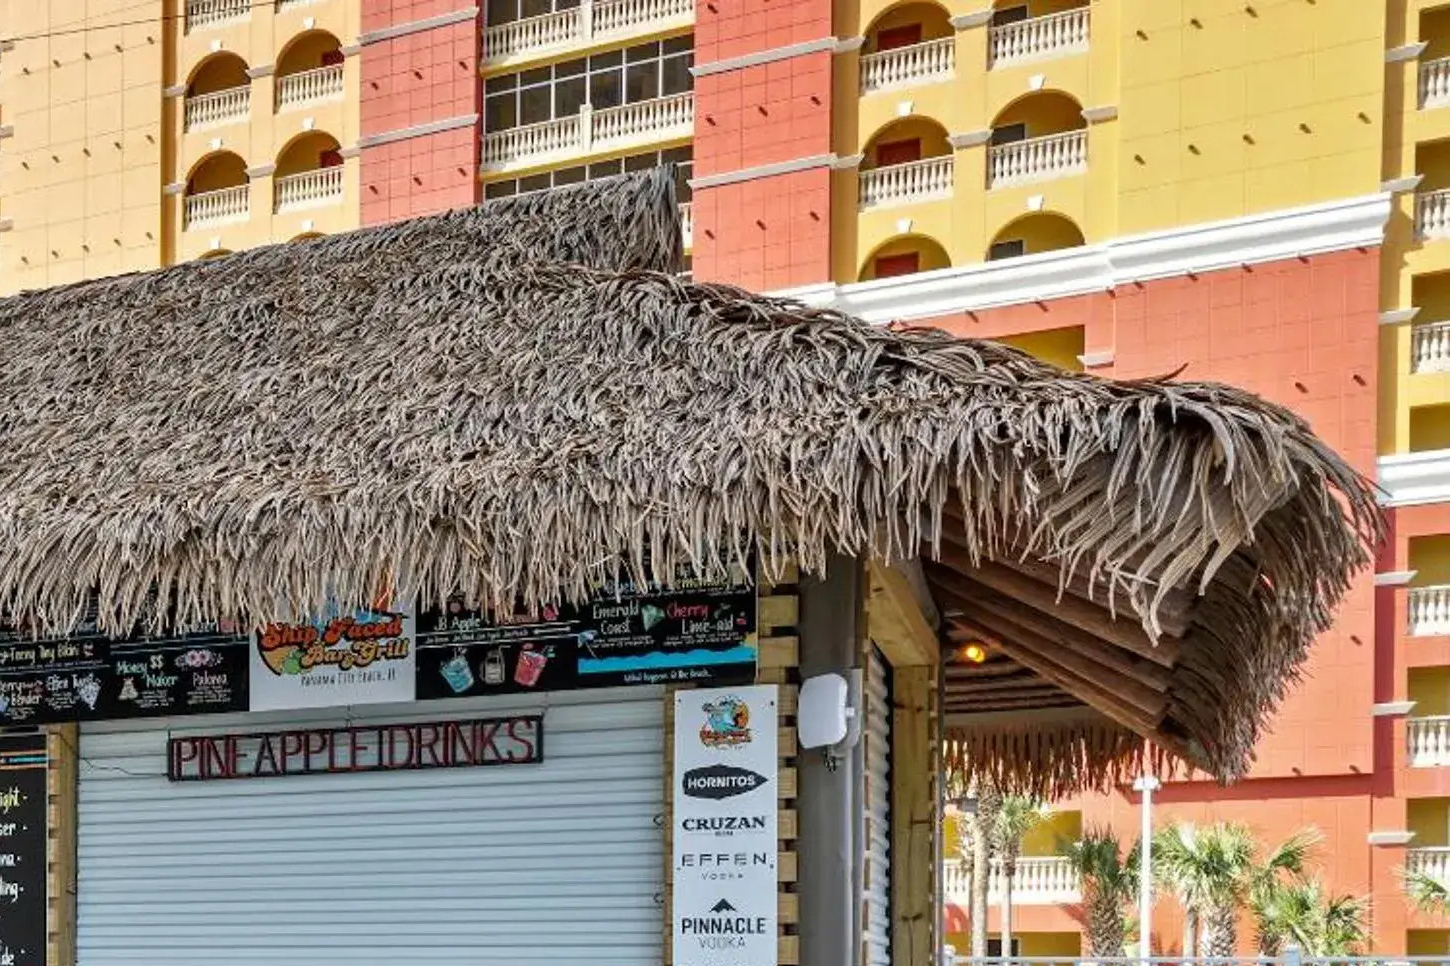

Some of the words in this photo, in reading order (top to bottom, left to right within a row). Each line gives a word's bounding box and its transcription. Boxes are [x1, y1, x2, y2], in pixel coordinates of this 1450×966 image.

[592, 601, 639, 619] Emerald
[667, 602, 709, 618] Cherry
[452, 612, 481, 633] Apple
[601, 618, 631, 635] Coast
[261, 622, 319, 649] Ship
[323, 616, 403, 645] Faced
[174, 728, 370, 780] PINEAPPLE
[388, 717, 534, 769] DRINKS
[687, 773, 756, 789] HORNITOS
[682, 816, 766, 832] CRUZAN
[682, 852, 767, 868] EFFEN
[682, 917, 766, 935] PINNACLE
